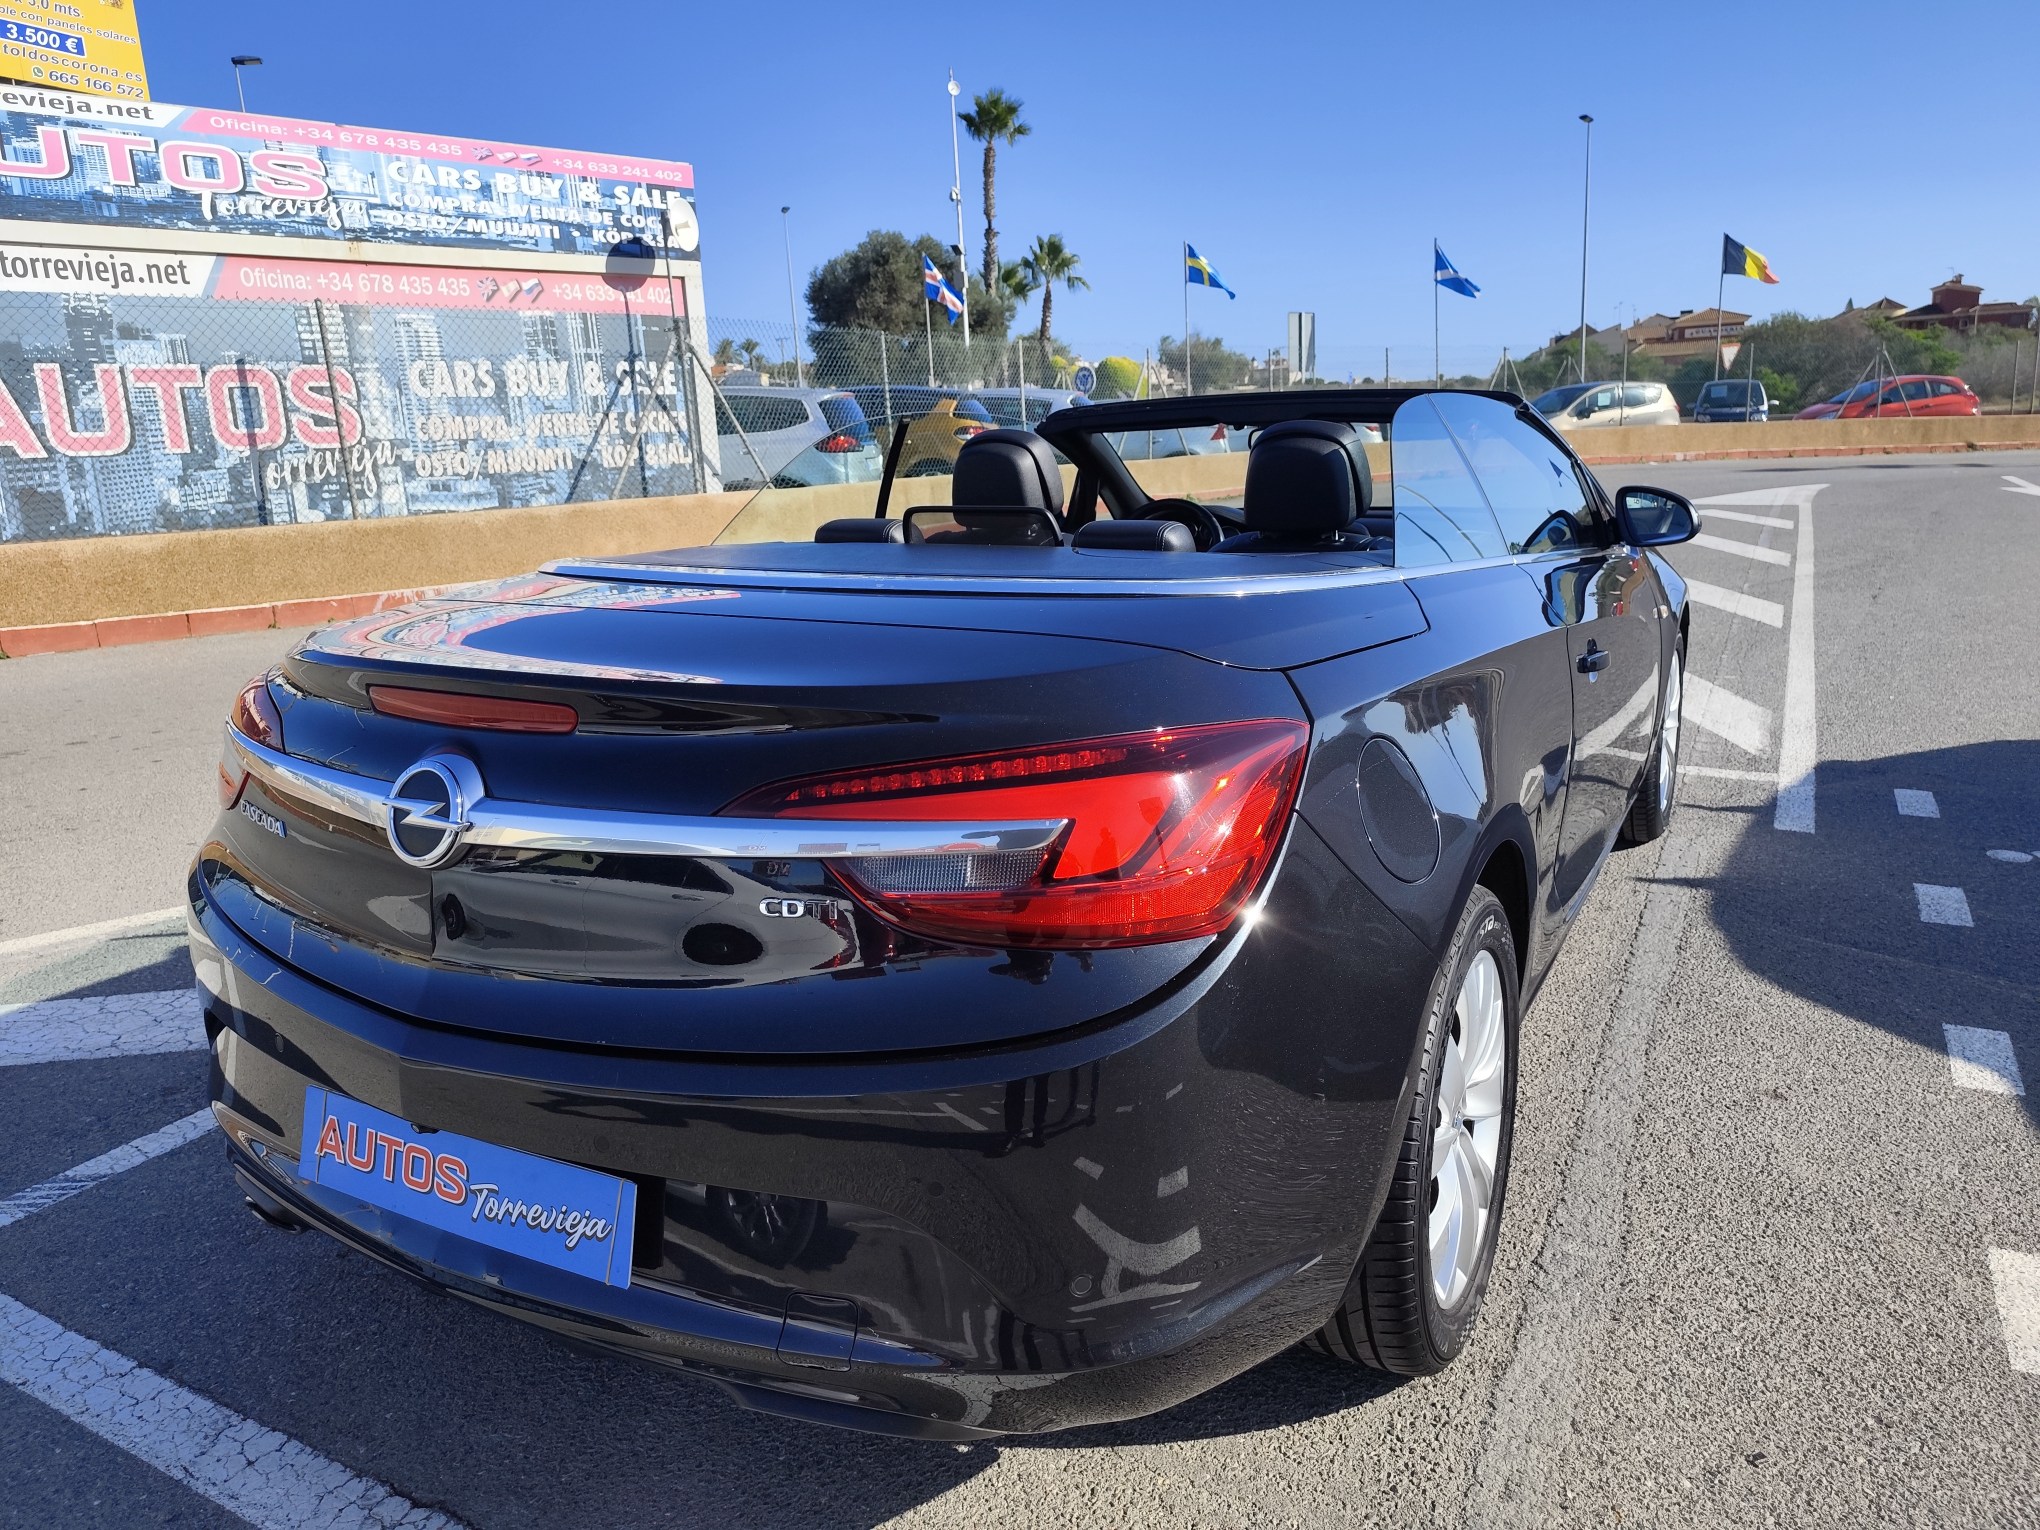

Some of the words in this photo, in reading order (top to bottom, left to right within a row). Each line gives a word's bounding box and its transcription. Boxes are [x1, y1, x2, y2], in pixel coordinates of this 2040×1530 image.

[20, 11, 43, 22] con
[47, 17, 93, 34] paneles
[96, 28, 137, 45] solares
[54, 3, 84, 18] mts.
[6, 23, 61, 48] 3.500
[65, 38, 78, 53] €
[2, 43, 142, 82] toldoscorona.es
[49, 70, 79, 85] 665
[84, 77, 112, 92] 166
[117, 84, 144, 99] 572
[0, 92, 154, 120] evieja.net
[210, 116, 288, 137] Oficina:
[294, 128, 333, 142] +34
[340, 132, 378, 146] 678
[384, 137, 422, 151] 435
[427, 141, 463, 156] 435
[553, 157, 583, 170] +34
[588, 162, 618, 174] 633
[622, 165, 651, 178] 241
[654, 170, 682, 181] 402
[387, 160, 483, 192] CARS
[495, 172, 564, 199] BUY
[580, 181, 603, 204] &
[589, 210, 614, 226] DE
[239, 267, 312, 291] Oficina:
[317, 272, 353, 292] +34
[358, 273, 394, 293] 678
[399, 276, 433, 295] 435
[437, 277, 470, 297] 435
[552, 283, 582, 302] +34
[586, 283, 616, 302] 633
[646, 286, 672, 304] 402
[408, 359, 497, 399] CARS
[503, 359, 569, 397] BUY
[583, 360, 608, 397] &
[415, 414, 511, 442] COMPRA
[240, 799, 287, 839] CASCADA
[759, 896, 838, 920] CDTI
[314, 1114, 470, 1205] AUTOS
[470, 1182, 613, 1248] Torrevieja
